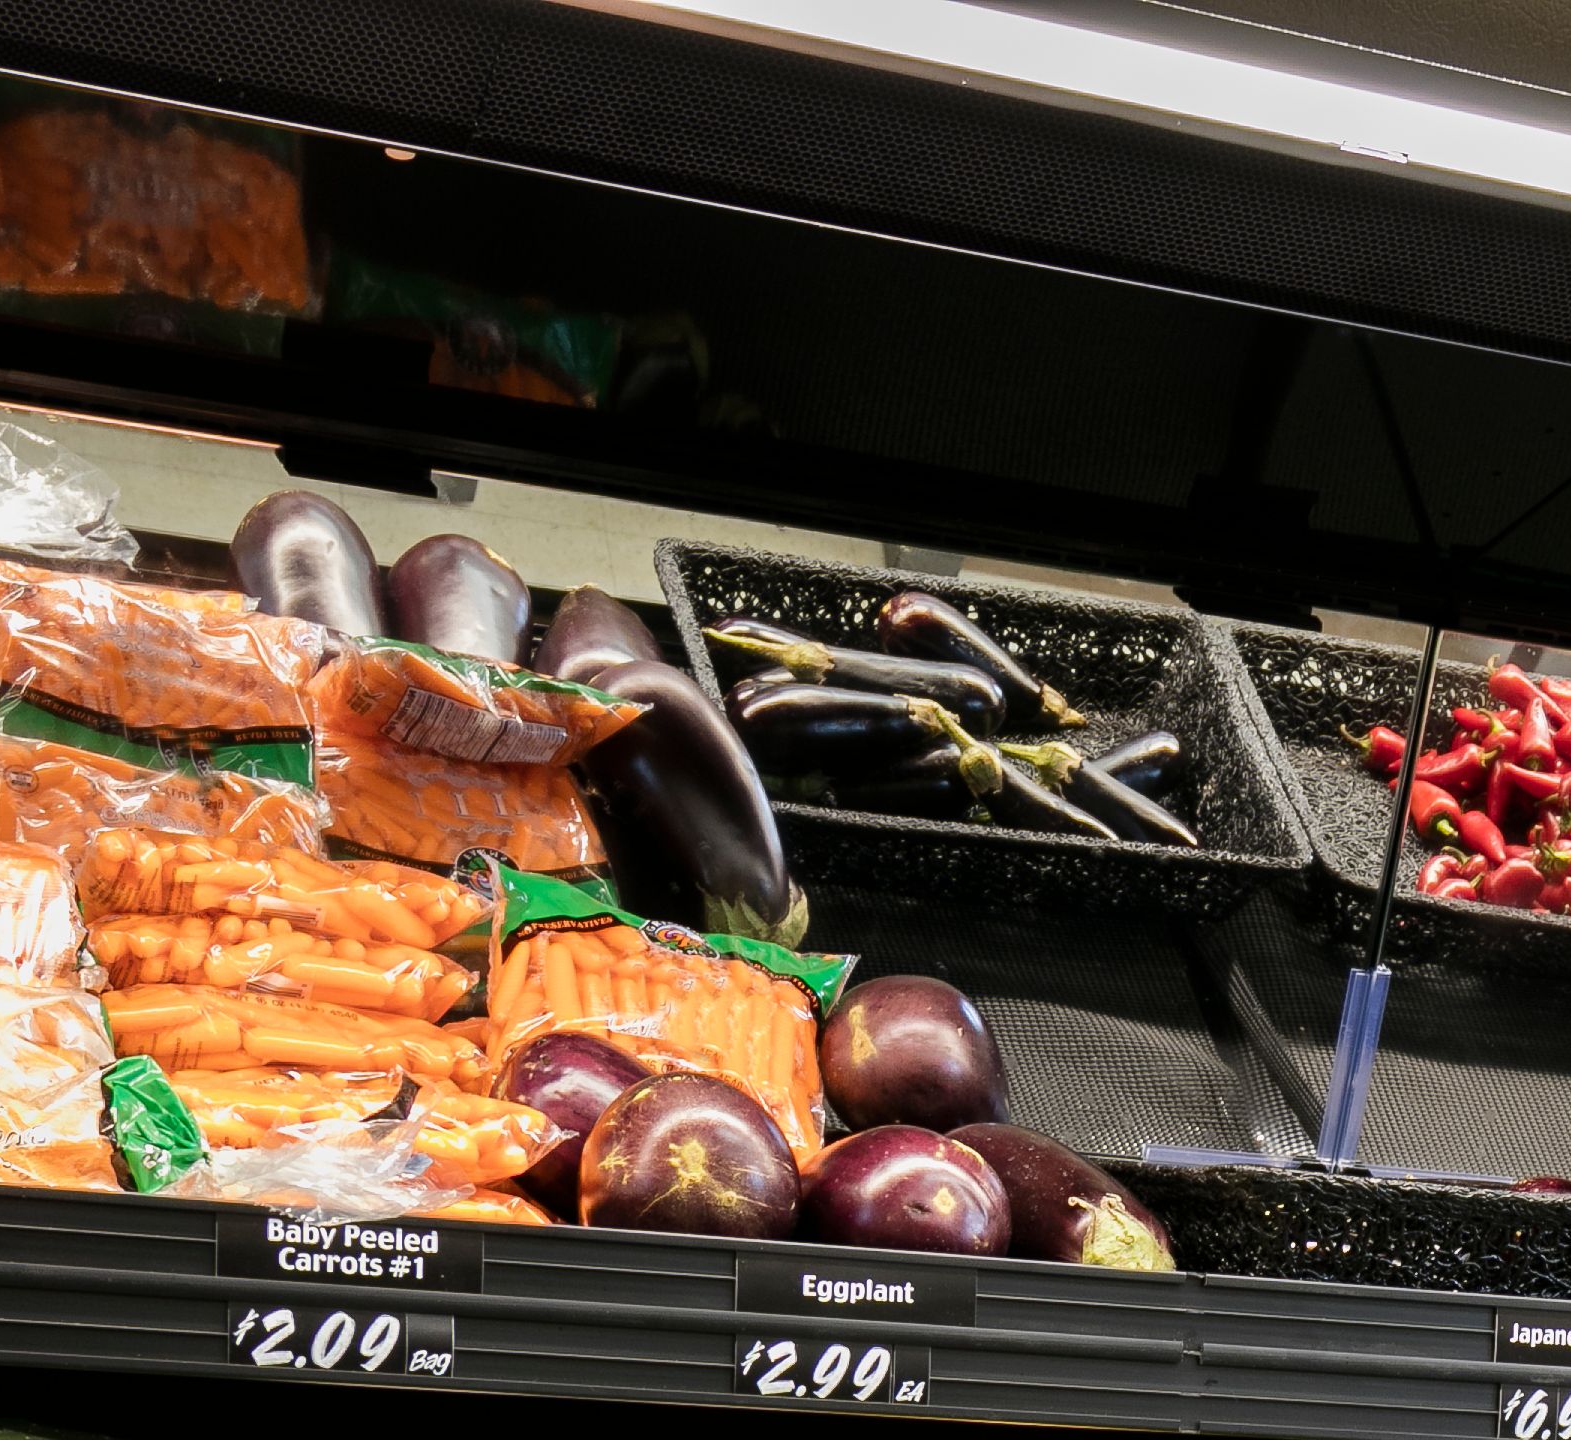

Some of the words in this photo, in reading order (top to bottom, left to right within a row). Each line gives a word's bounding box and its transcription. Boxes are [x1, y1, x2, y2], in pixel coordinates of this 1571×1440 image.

[267, 1219, 333, 1250] Baby
[340, 1225, 438, 1256] Peeled
[279, 1249, 383, 1278] Carrots
[391, 1253, 425, 1279] #1
[803, 1276, 914, 1305] Eggplant
[233, 1308, 400, 1369] $2.09
